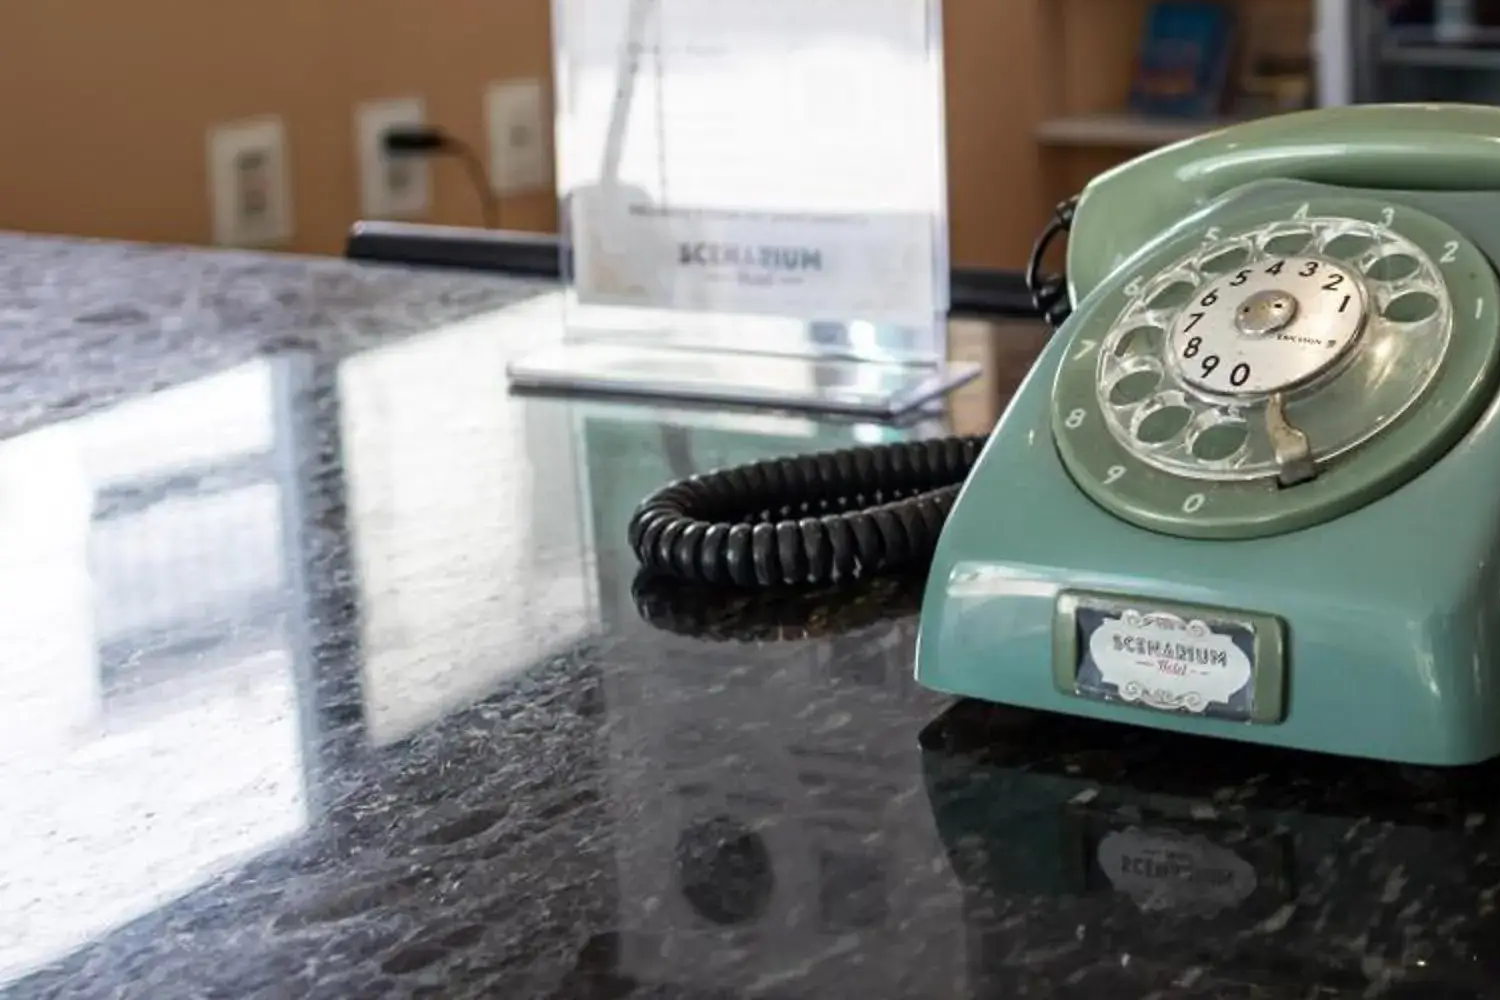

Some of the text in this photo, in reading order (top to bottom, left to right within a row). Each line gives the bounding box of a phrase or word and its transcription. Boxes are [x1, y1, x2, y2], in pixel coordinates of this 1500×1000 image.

[1378, 207, 1396, 226] 3
[1440, 241, 1459, 264] 2
[1229, 269, 1253, 287] 5
[1264, 260, 1286, 276] 4
[1298, 261, 1319, 277] 3
[1321, 273, 1345, 291] 2
[1200, 288, 1220, 307] 6
[1338, 295, 1351, 313] 1
[1475, 297, 1484, 318] 1
[1183, 312, 1206, 333] 7
[1073, 339, 1097, 360] 7
[1183, 336, 1202, 359] 8
[1200, 355, 1220, 379] 9
[1230, 362, 1251, 387] 0
[1065, 408, 1085, 428] 8
[1104, 465, 1127, 484] 9
[1182, 493, 1205, 514] 0
